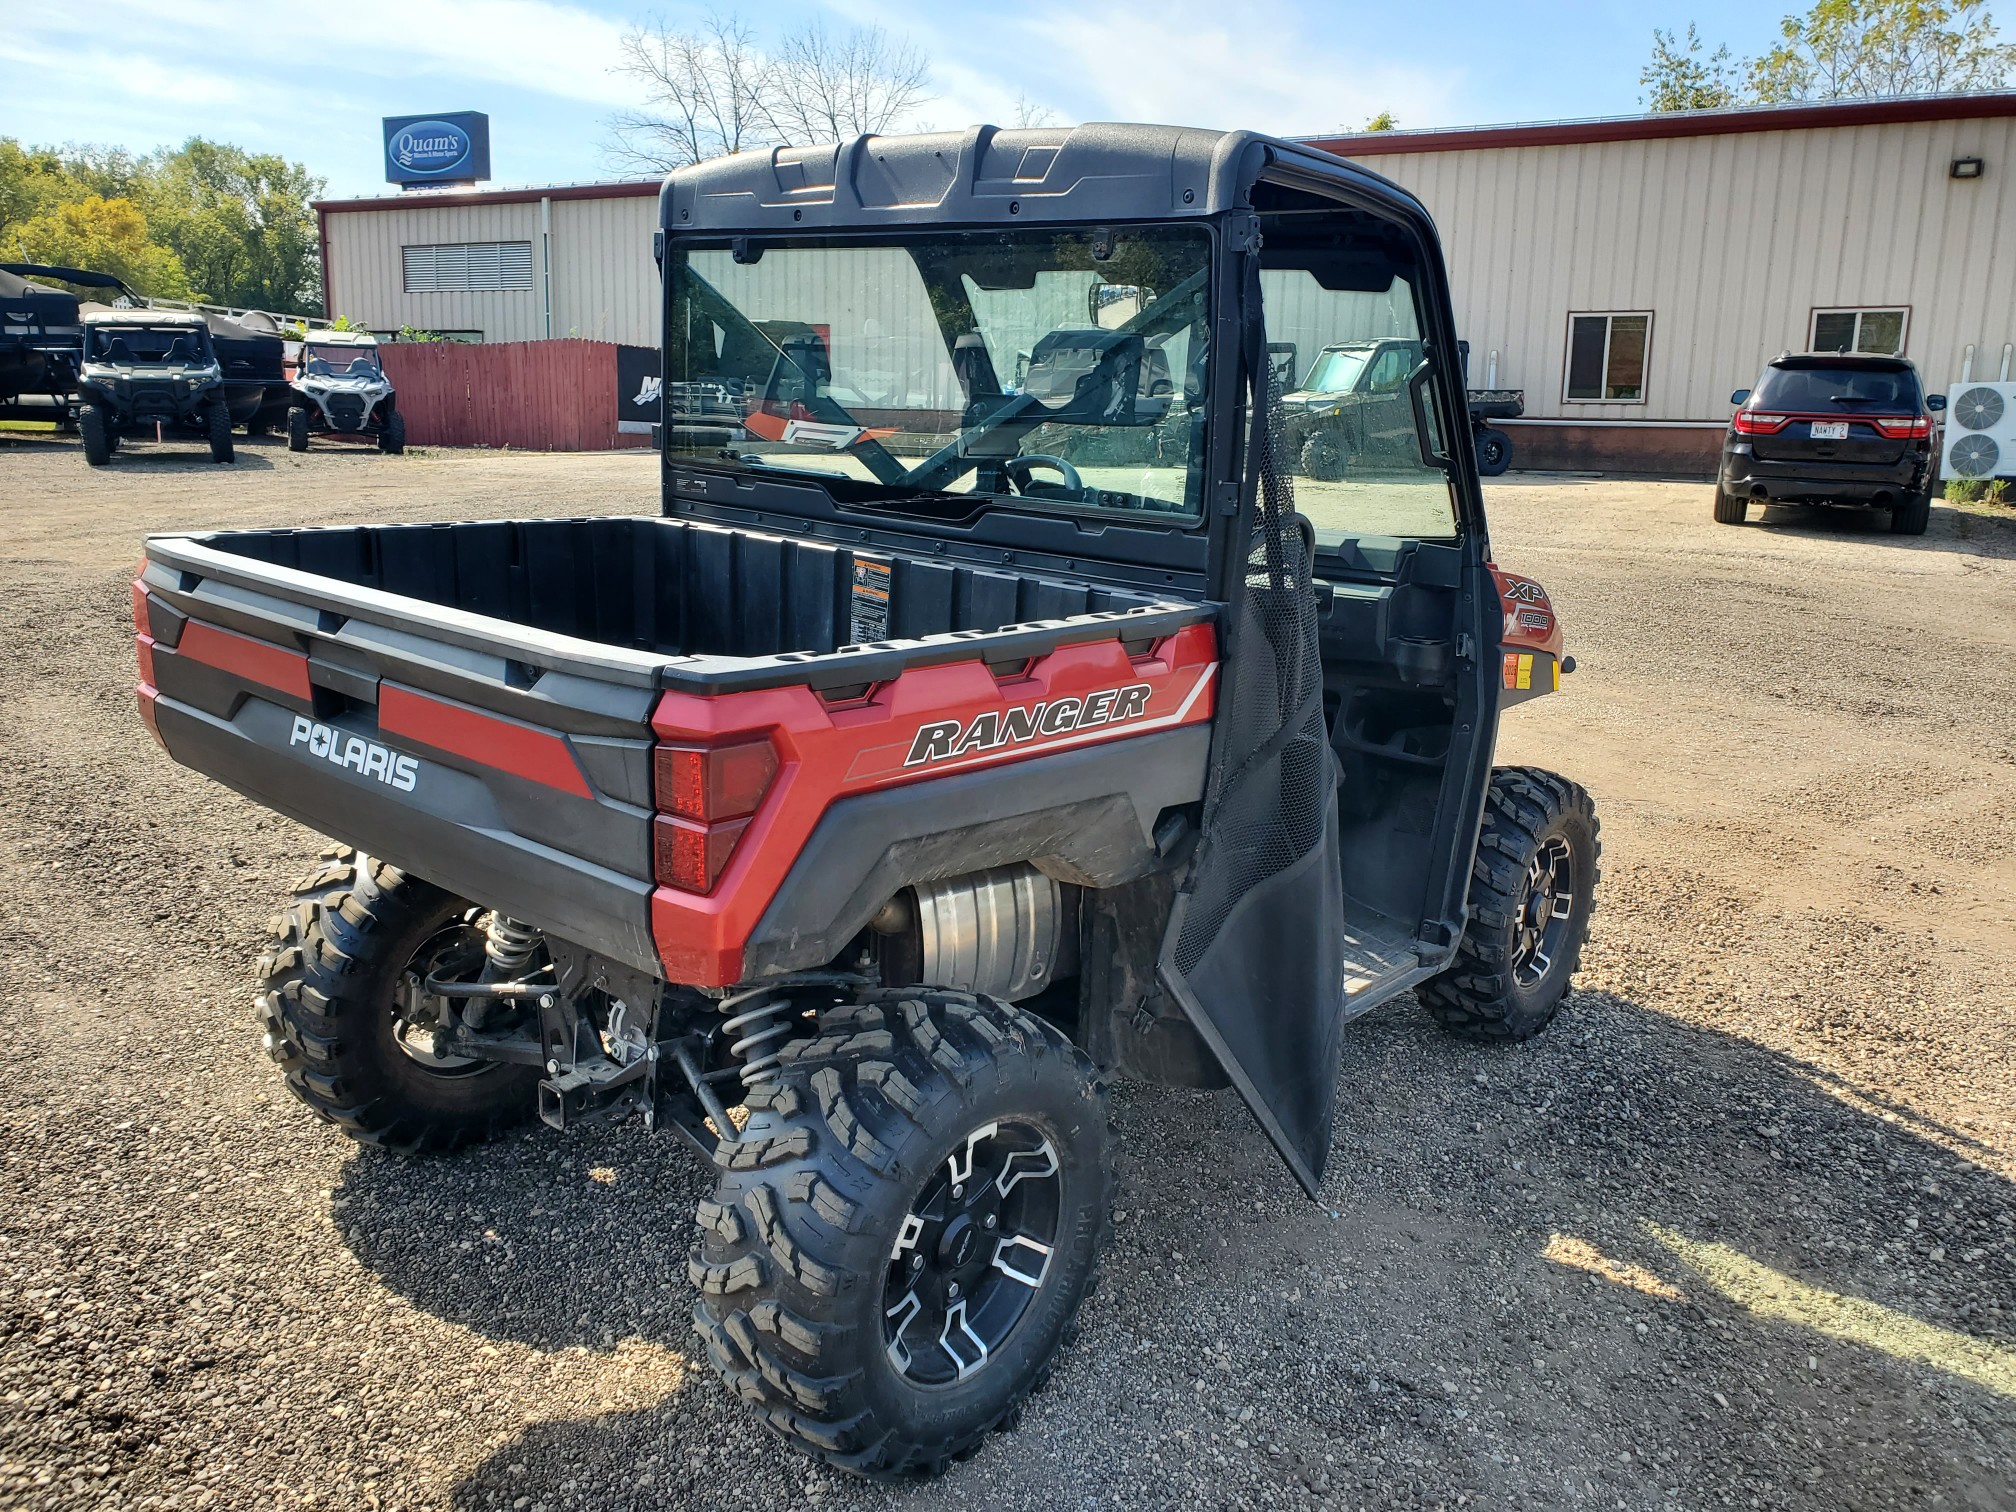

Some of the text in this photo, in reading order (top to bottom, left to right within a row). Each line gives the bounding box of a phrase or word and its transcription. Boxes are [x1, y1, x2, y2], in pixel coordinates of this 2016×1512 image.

[399, 133, 459, 156] Quam's
[1814, 426, 1836, 434] NAWTY
[1503, 578, 1544, 602] XP
[1520, 612, 1549, 627] 1000
[902, 684, 1153, 767] RANGER
[289, 715, 419, 792] POLARIS
